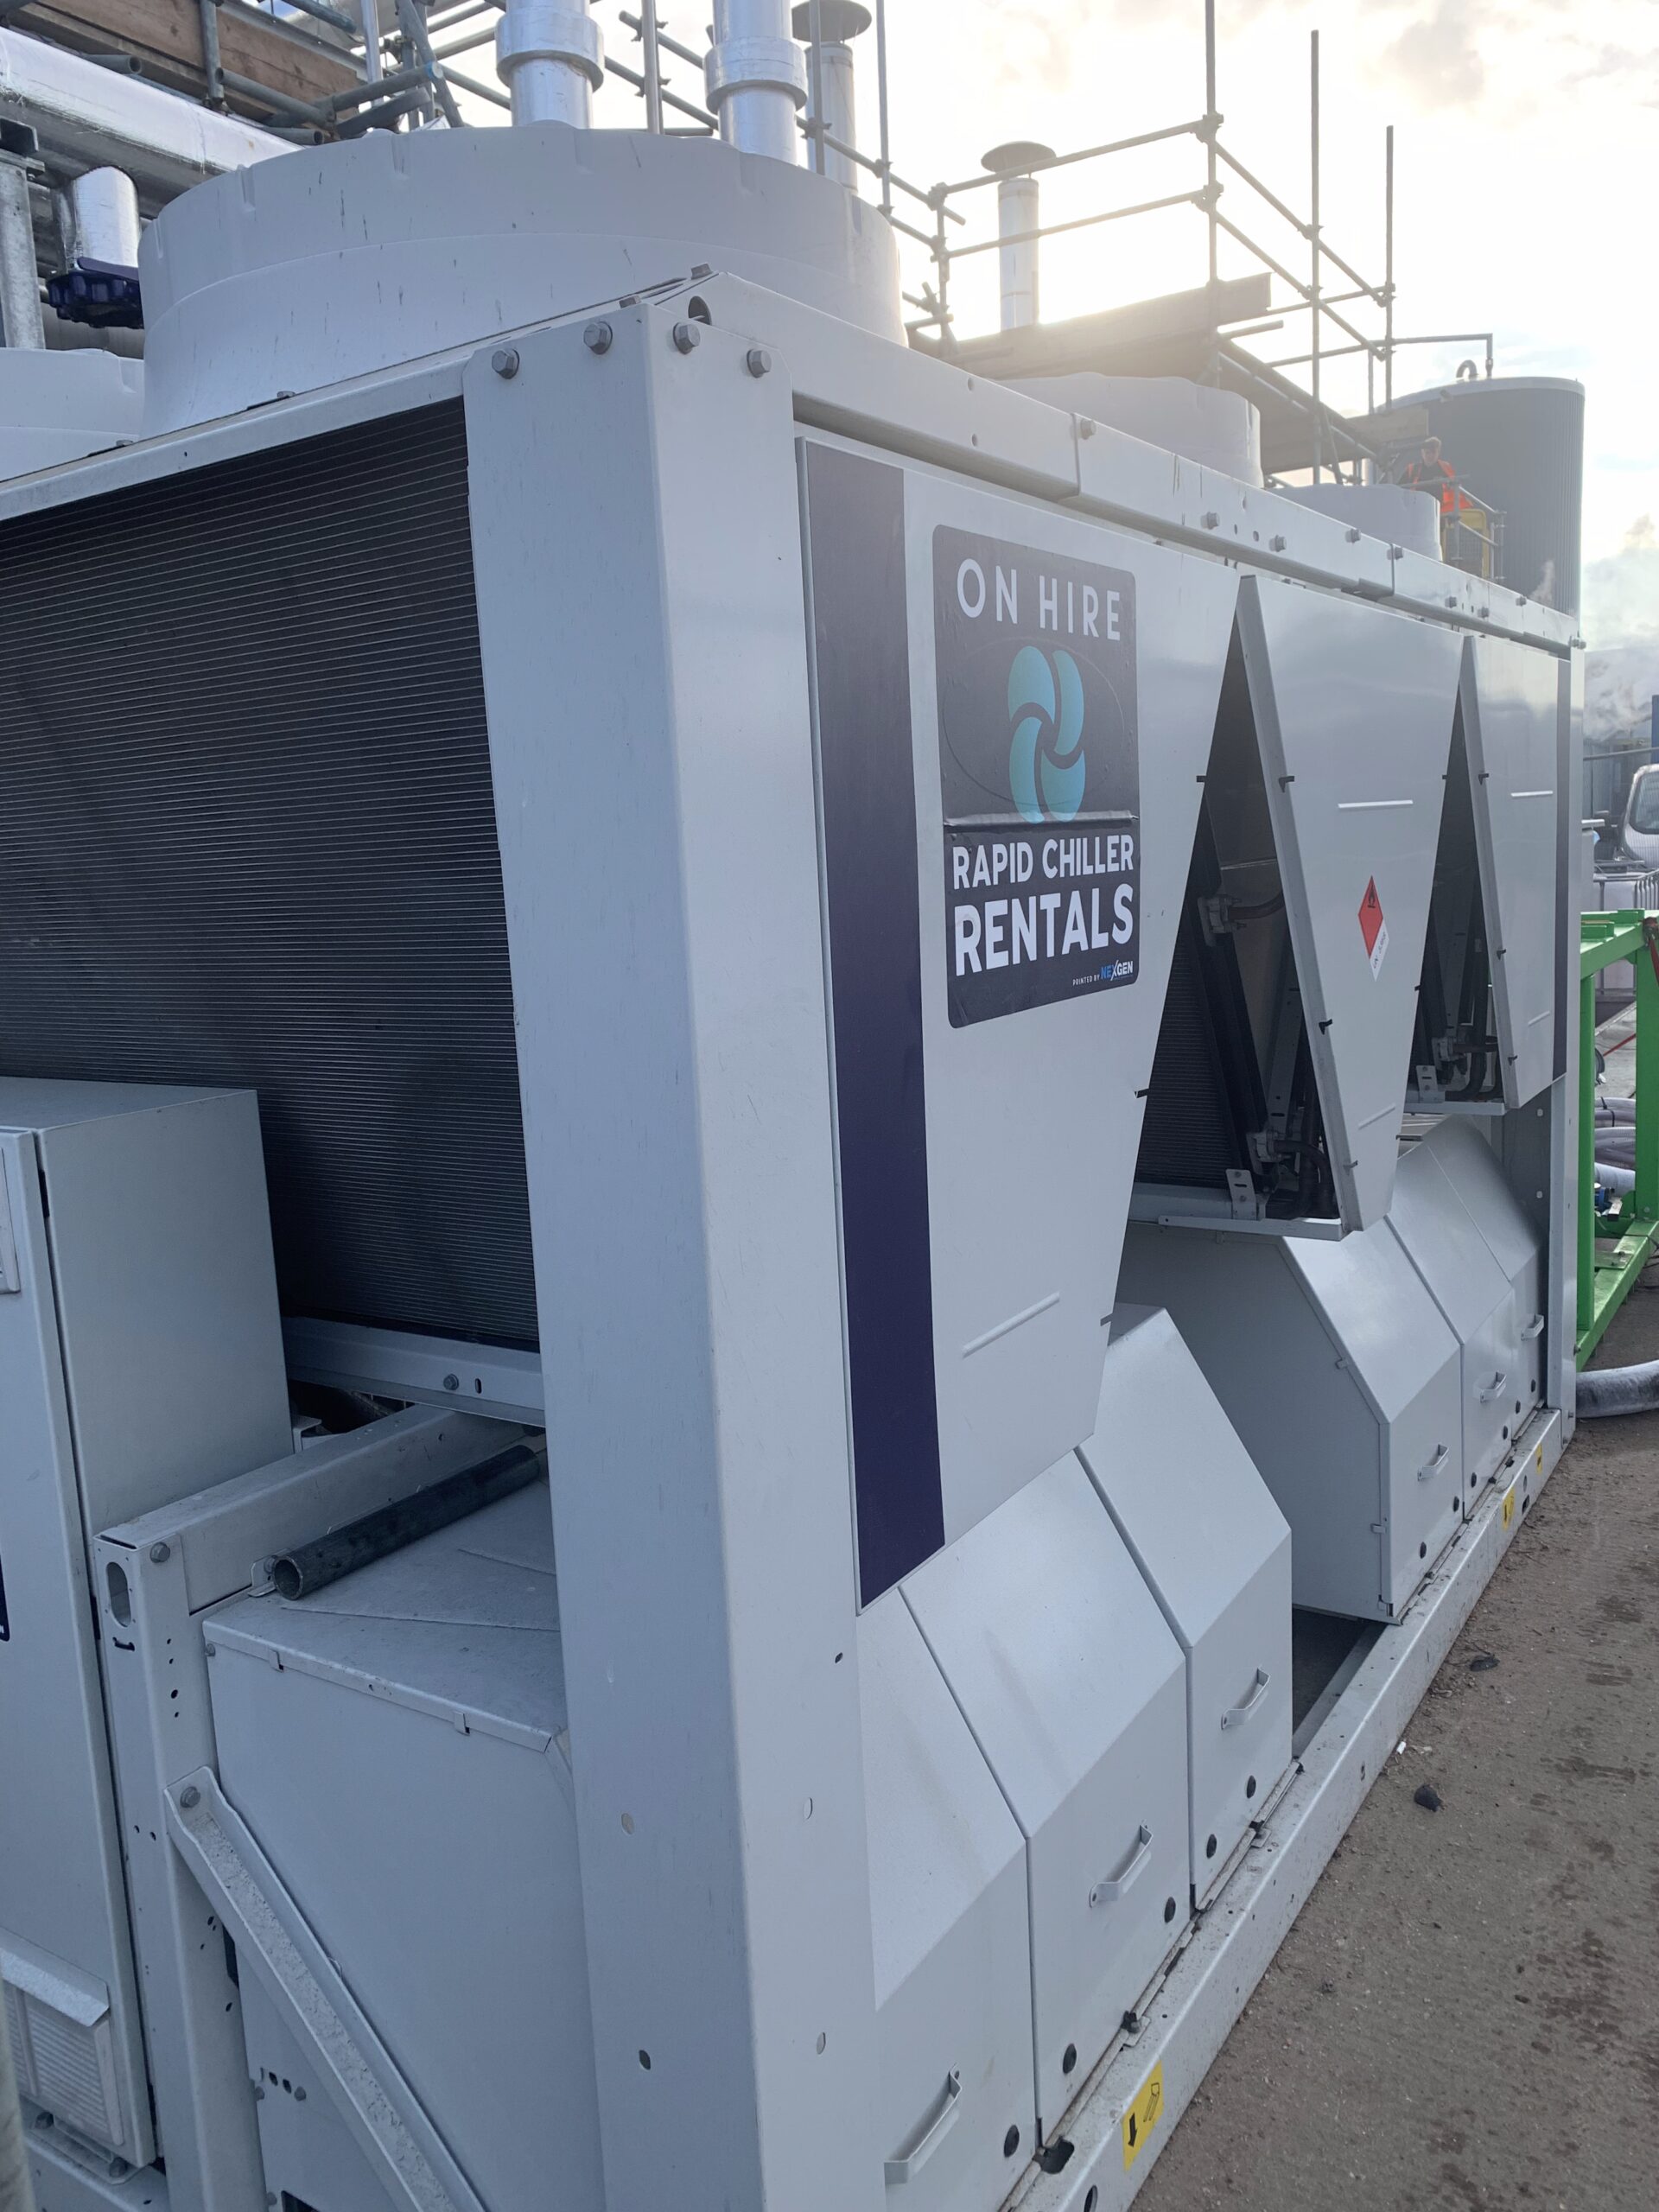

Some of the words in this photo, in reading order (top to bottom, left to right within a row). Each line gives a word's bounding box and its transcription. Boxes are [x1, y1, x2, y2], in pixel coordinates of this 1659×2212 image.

[957, 558, 1018, 625] ON
[1039, 575, 1121, 641] HIRE
[952, 841, 1034, 890] RAPID
[1042, 834, 1134, 879] CHILLER
[954, 883, 1134, 976] RENTALS
[1072, 974, 1092, 986] PRINTED
[1093, 974, 1100, 982] BY
[1100, 960, 1134, 981] NEXGEN
